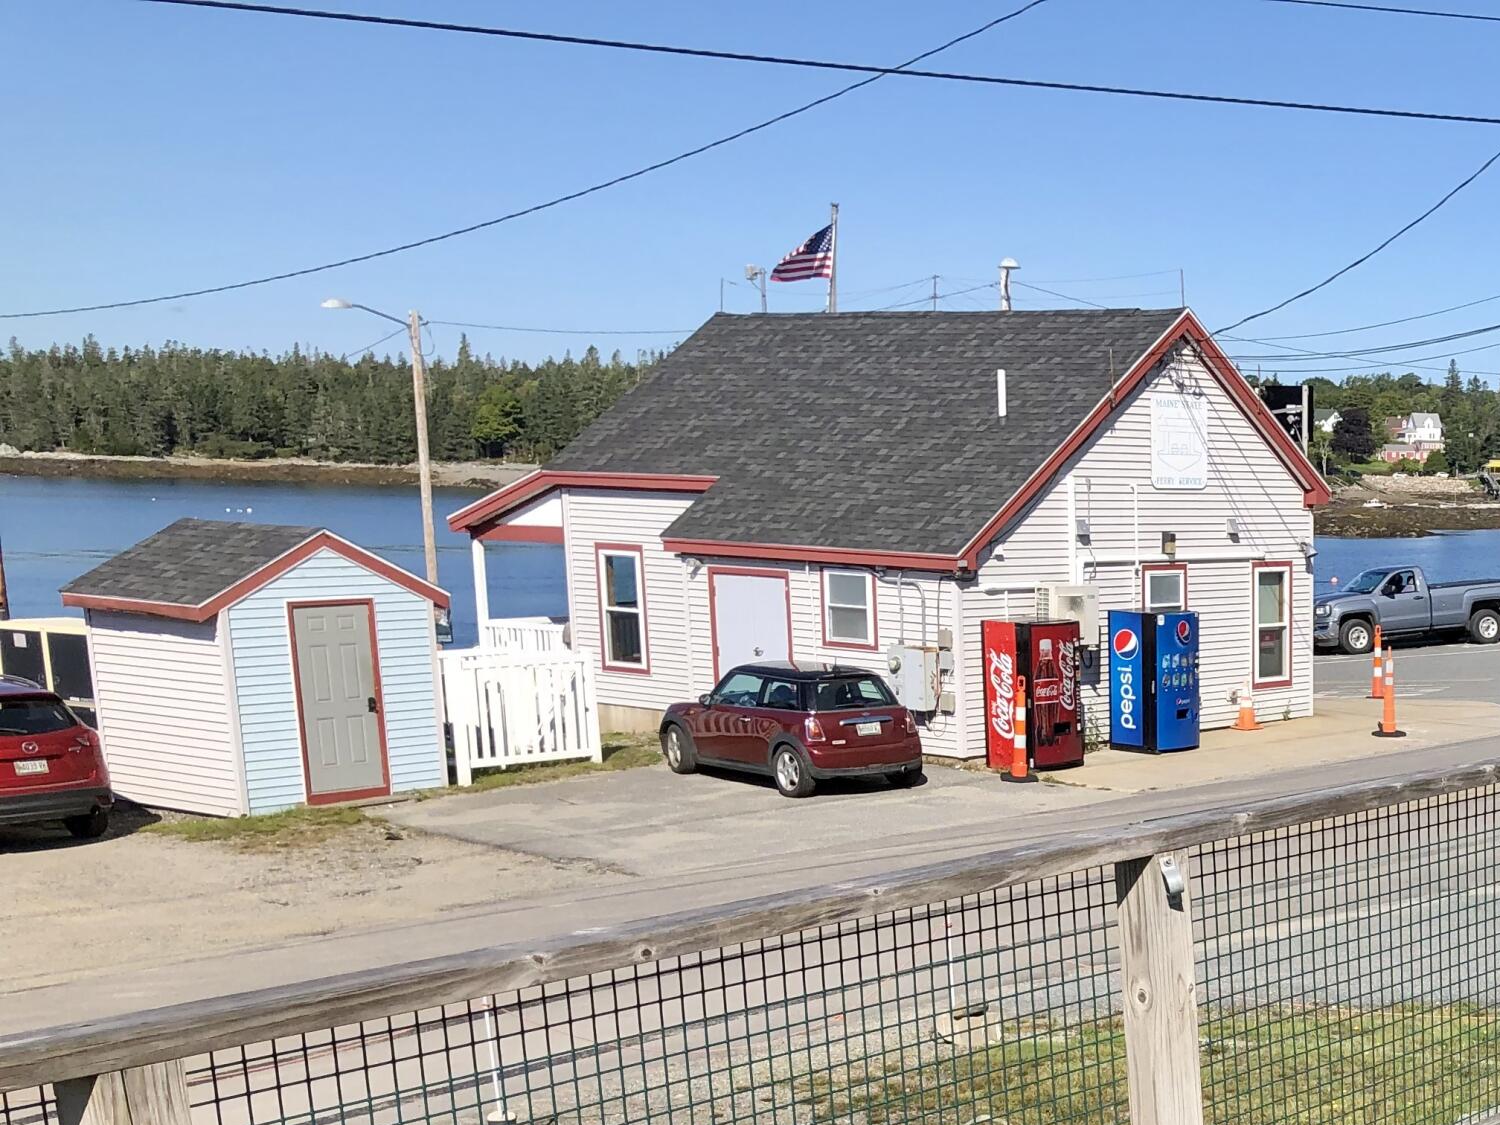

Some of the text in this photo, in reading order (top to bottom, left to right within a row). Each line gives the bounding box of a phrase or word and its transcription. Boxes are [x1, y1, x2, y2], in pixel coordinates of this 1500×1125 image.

[1156, 399, 1180, 408] MAINE
[990, 647, 1015, 739] Coca-Cola
[1059, 640, 1075, 711] Coca-Cola
[1117, 664, 1137, 730] pepsi
